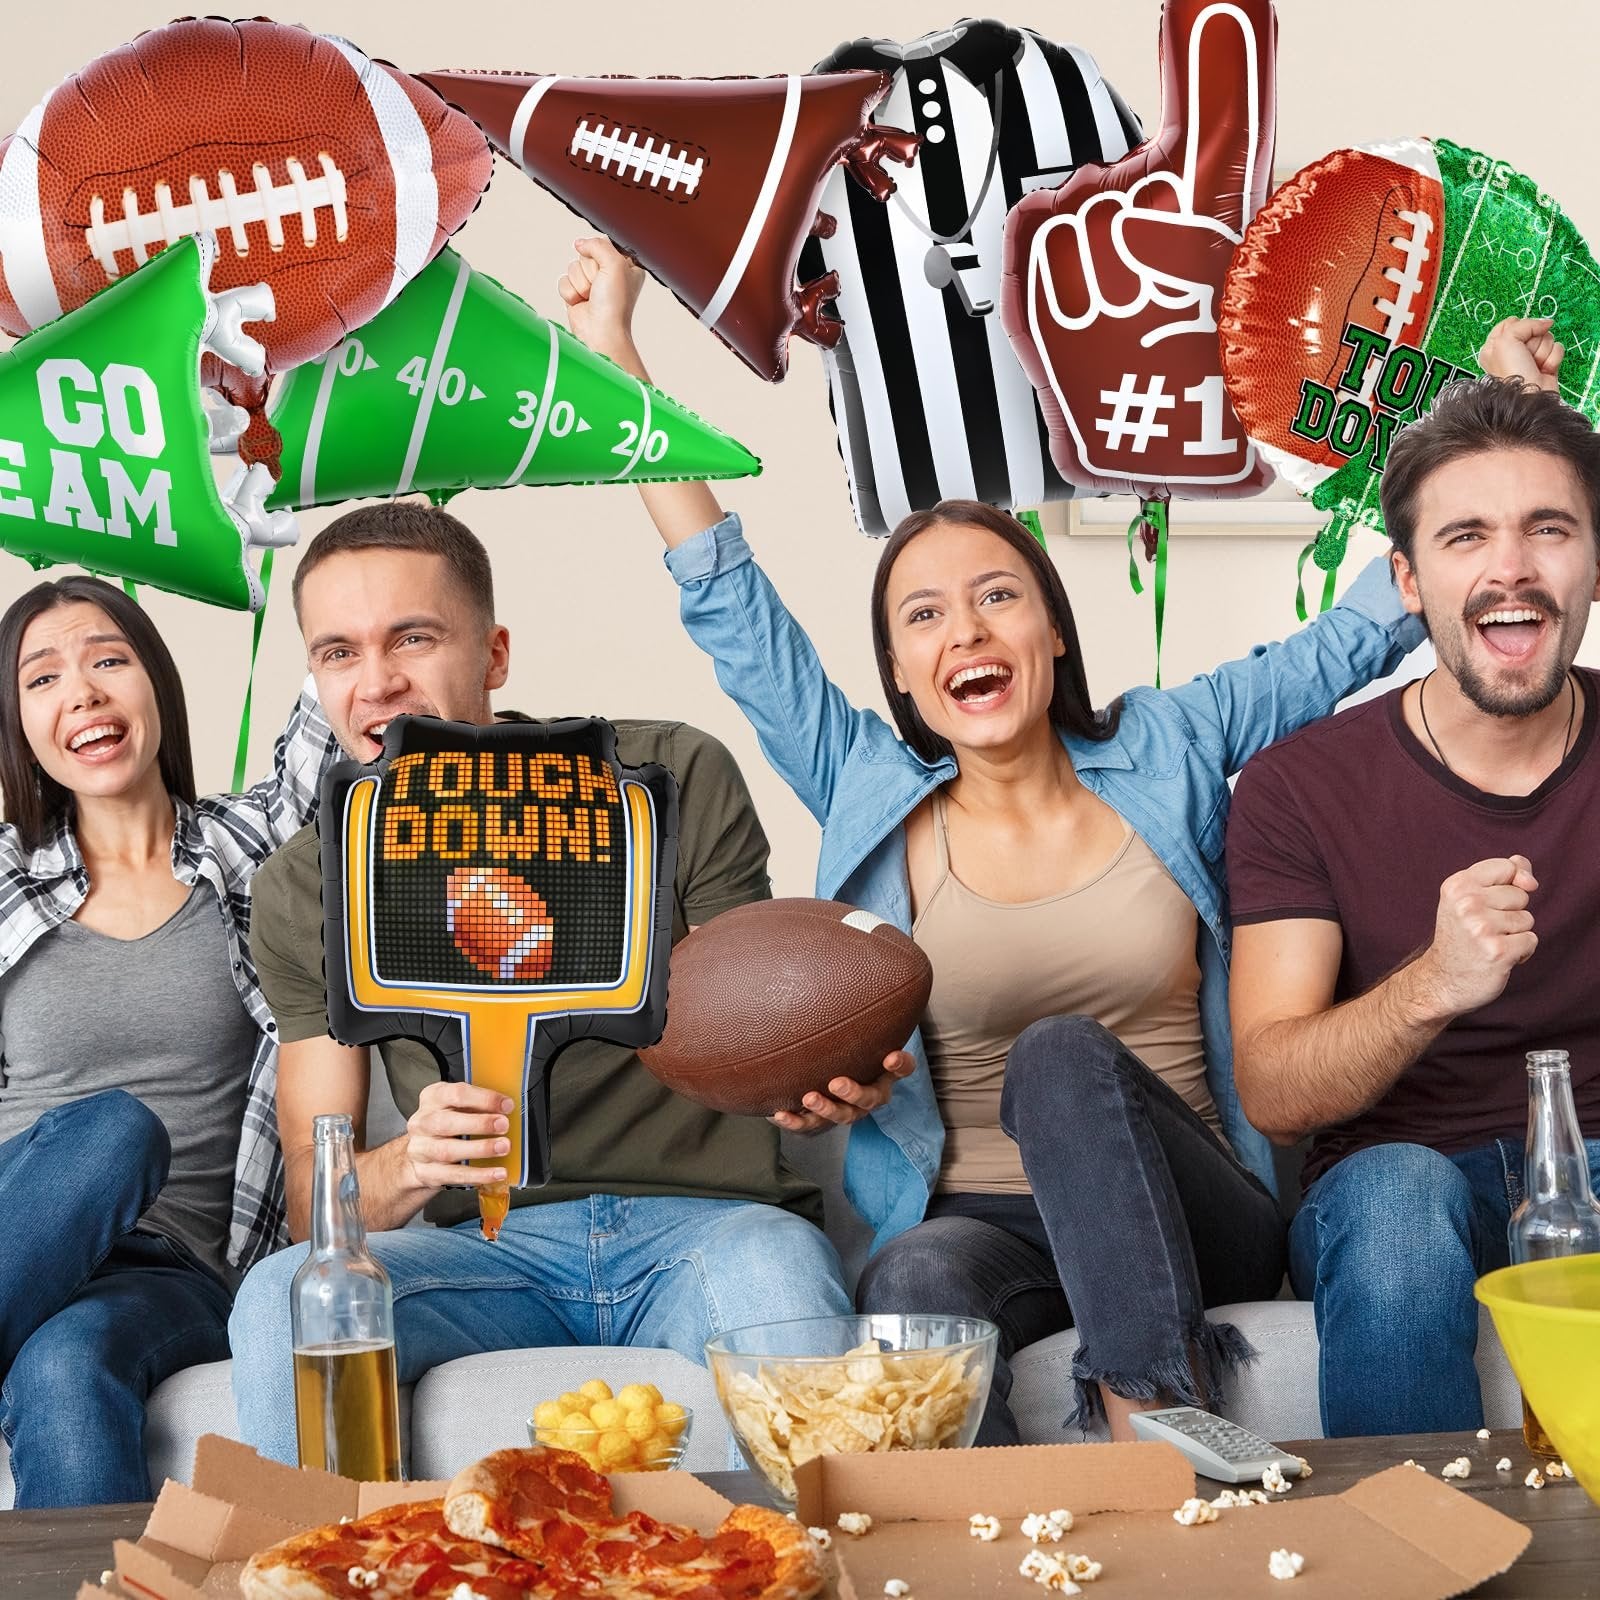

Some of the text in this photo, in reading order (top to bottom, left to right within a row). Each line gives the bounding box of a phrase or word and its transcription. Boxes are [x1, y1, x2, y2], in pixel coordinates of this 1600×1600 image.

[395, 355, 466, 406] 40
[36, 358, 166, 459] GO
[508, 390, 576, 438] 30
[1095, 373, 1238, 456] #1
[610, 420, 669, 464] 20
[388, 751, 619, 804] TOUCH
[383, 804, 611, 863] DOWN!
